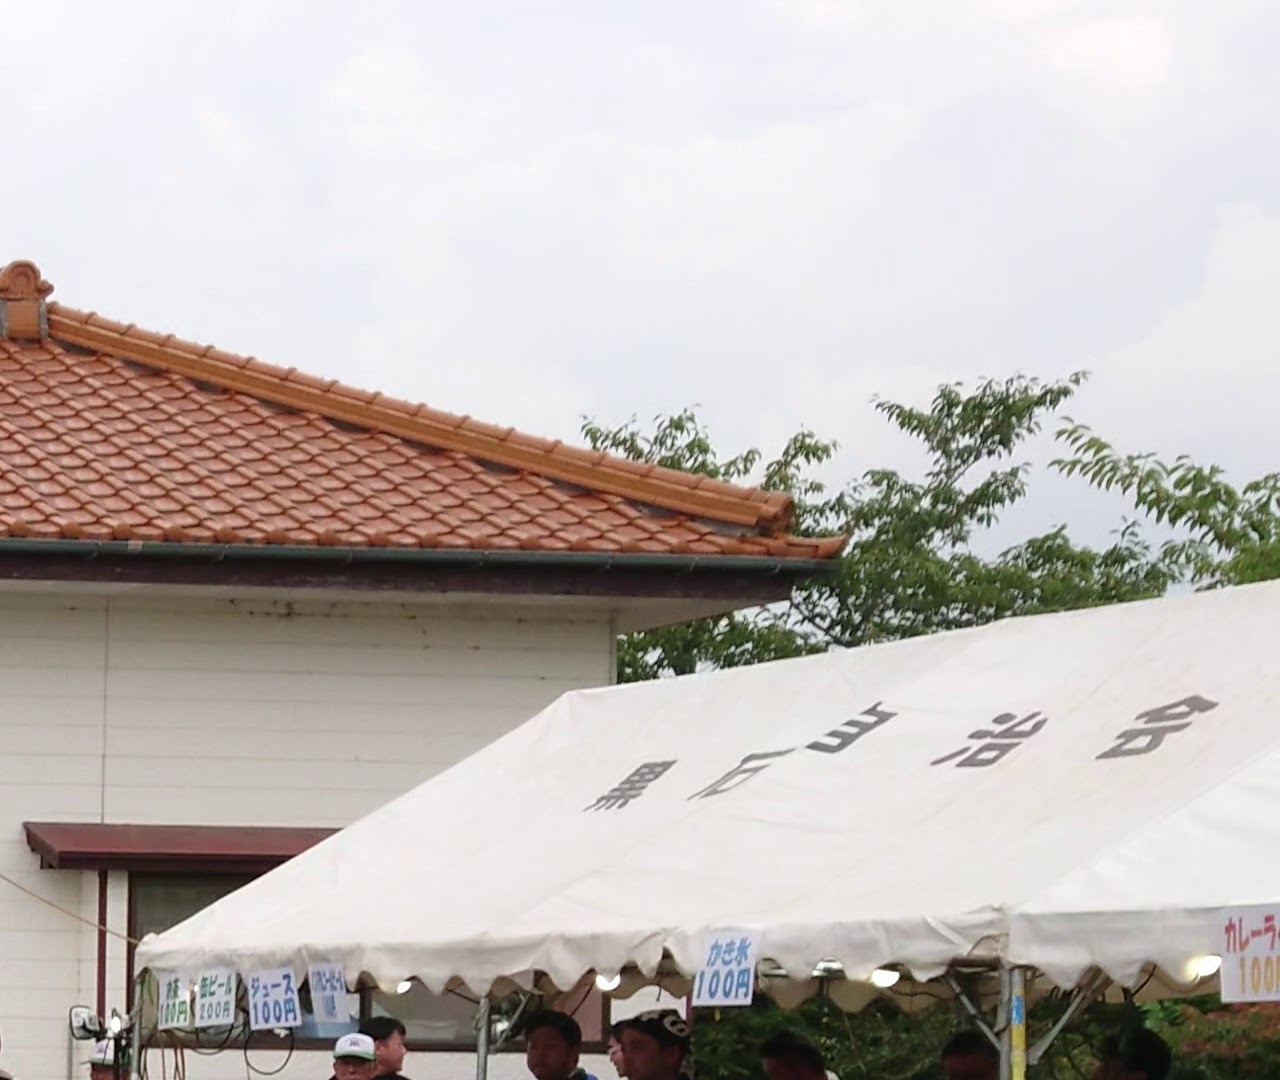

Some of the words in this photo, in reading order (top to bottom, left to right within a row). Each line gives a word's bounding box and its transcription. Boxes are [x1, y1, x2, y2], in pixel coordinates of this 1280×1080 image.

[1225, 915, 1280, 954] カレーラ
[707, 938, 751, 967] かき氷
[200, 974, 232, 999] 缶ビール
[251, 974, 294, 999] ジュース
[697, 967, 750, 999] 100円
[160, 1000, 187, 1025] 100円
[200, 1001, 230, 1019] 200円
[253, 998, 297, 1024] 100円
